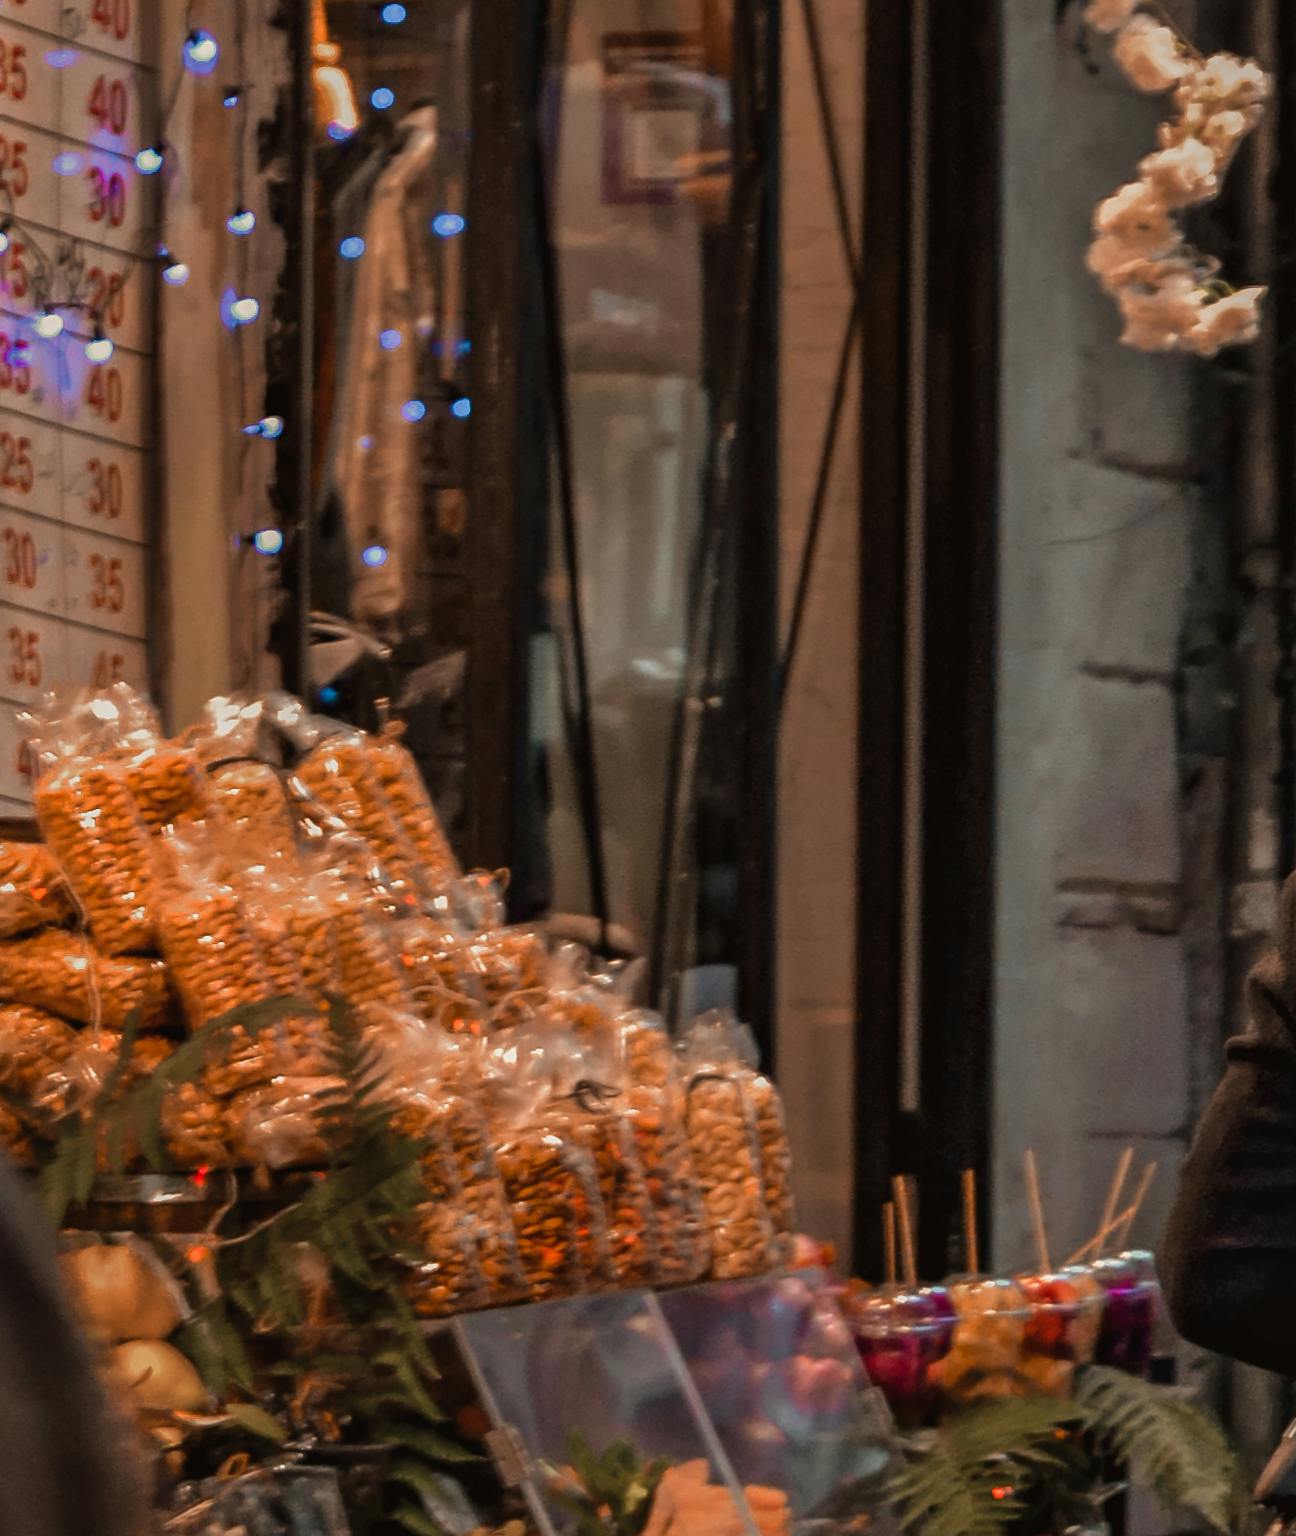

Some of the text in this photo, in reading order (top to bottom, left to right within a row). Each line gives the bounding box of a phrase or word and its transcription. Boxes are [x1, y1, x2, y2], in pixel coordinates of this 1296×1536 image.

[89, 74, 128, 135] 40
[88, 166, 126, 228] 30
[88, 362, 123, 421] 40
[0, 431, 124, 518] 25 30
[4, 526, 125, 612] 30 35
[8, 625, 42, 687] 35
